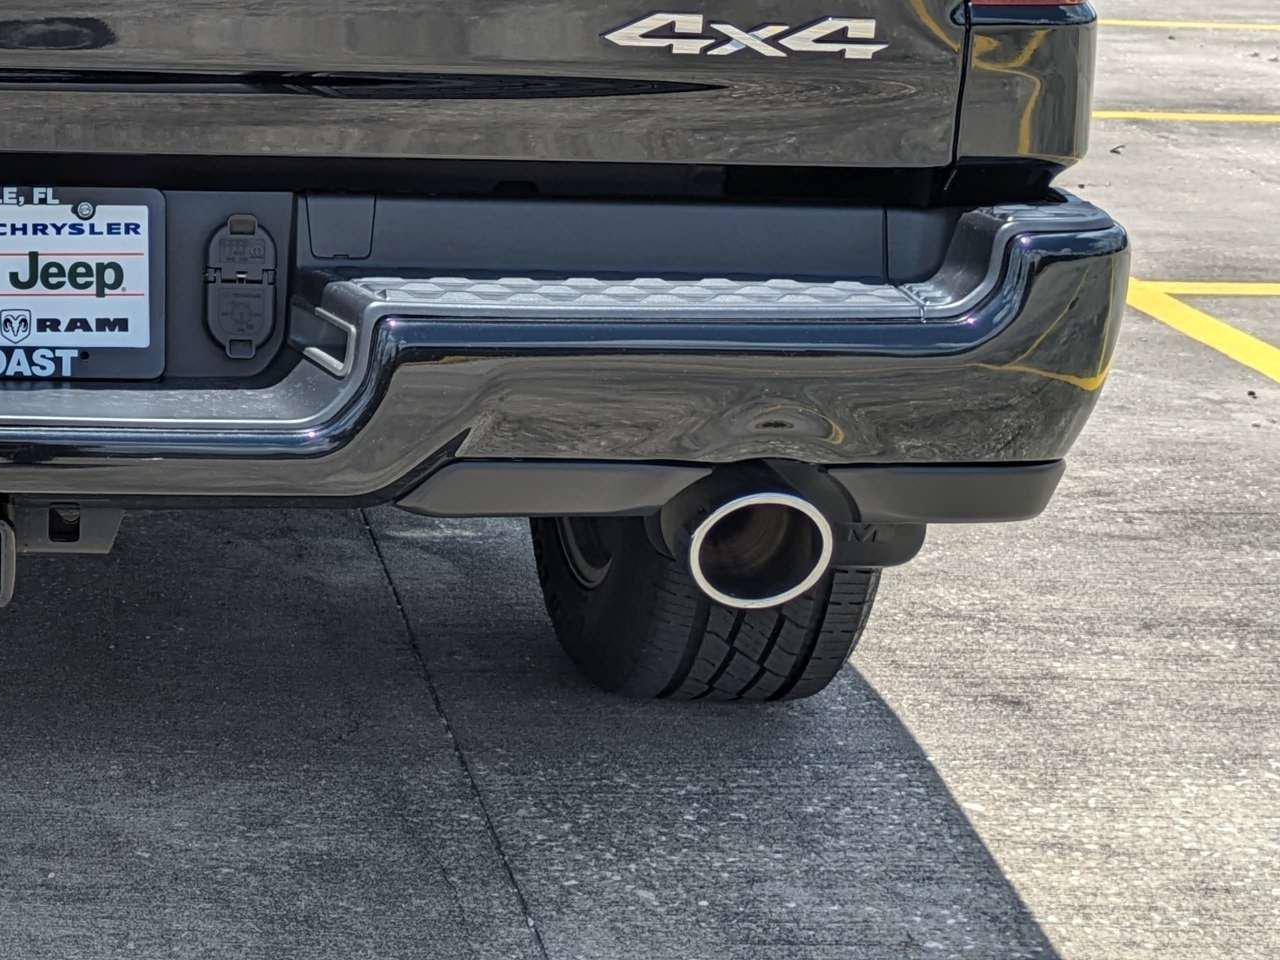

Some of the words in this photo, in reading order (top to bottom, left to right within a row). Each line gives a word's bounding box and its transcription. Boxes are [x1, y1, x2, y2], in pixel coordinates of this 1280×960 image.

[32, 188, 60, 205] FL
[8, 251, 124, 298] Jeep
[35, 317, 129, 333] RAM
